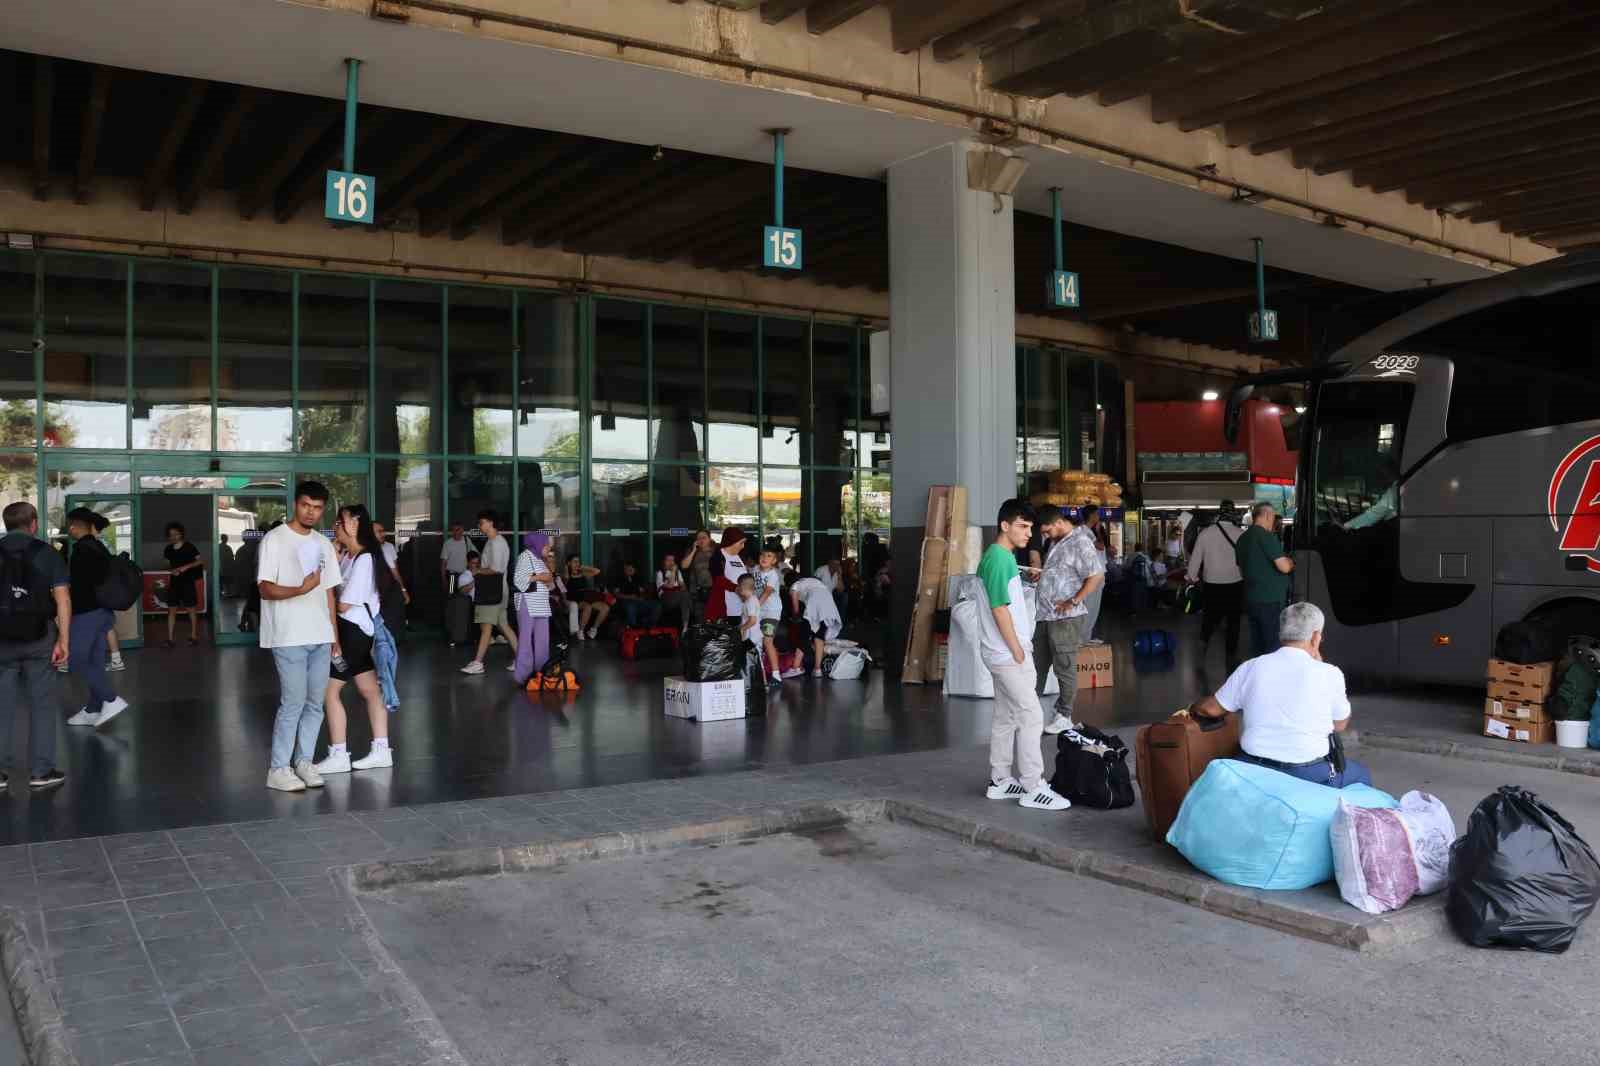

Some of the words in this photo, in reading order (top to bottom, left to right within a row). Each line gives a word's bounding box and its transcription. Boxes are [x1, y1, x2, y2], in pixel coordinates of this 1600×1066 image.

[333, 176, 368, 218] 16
[770, 230, 797, 265] 15
[1058, 274, 1076, 304] 14
[1264, 311, 1278, 338] 13
[1375, 355, 1420, 369] 2023
